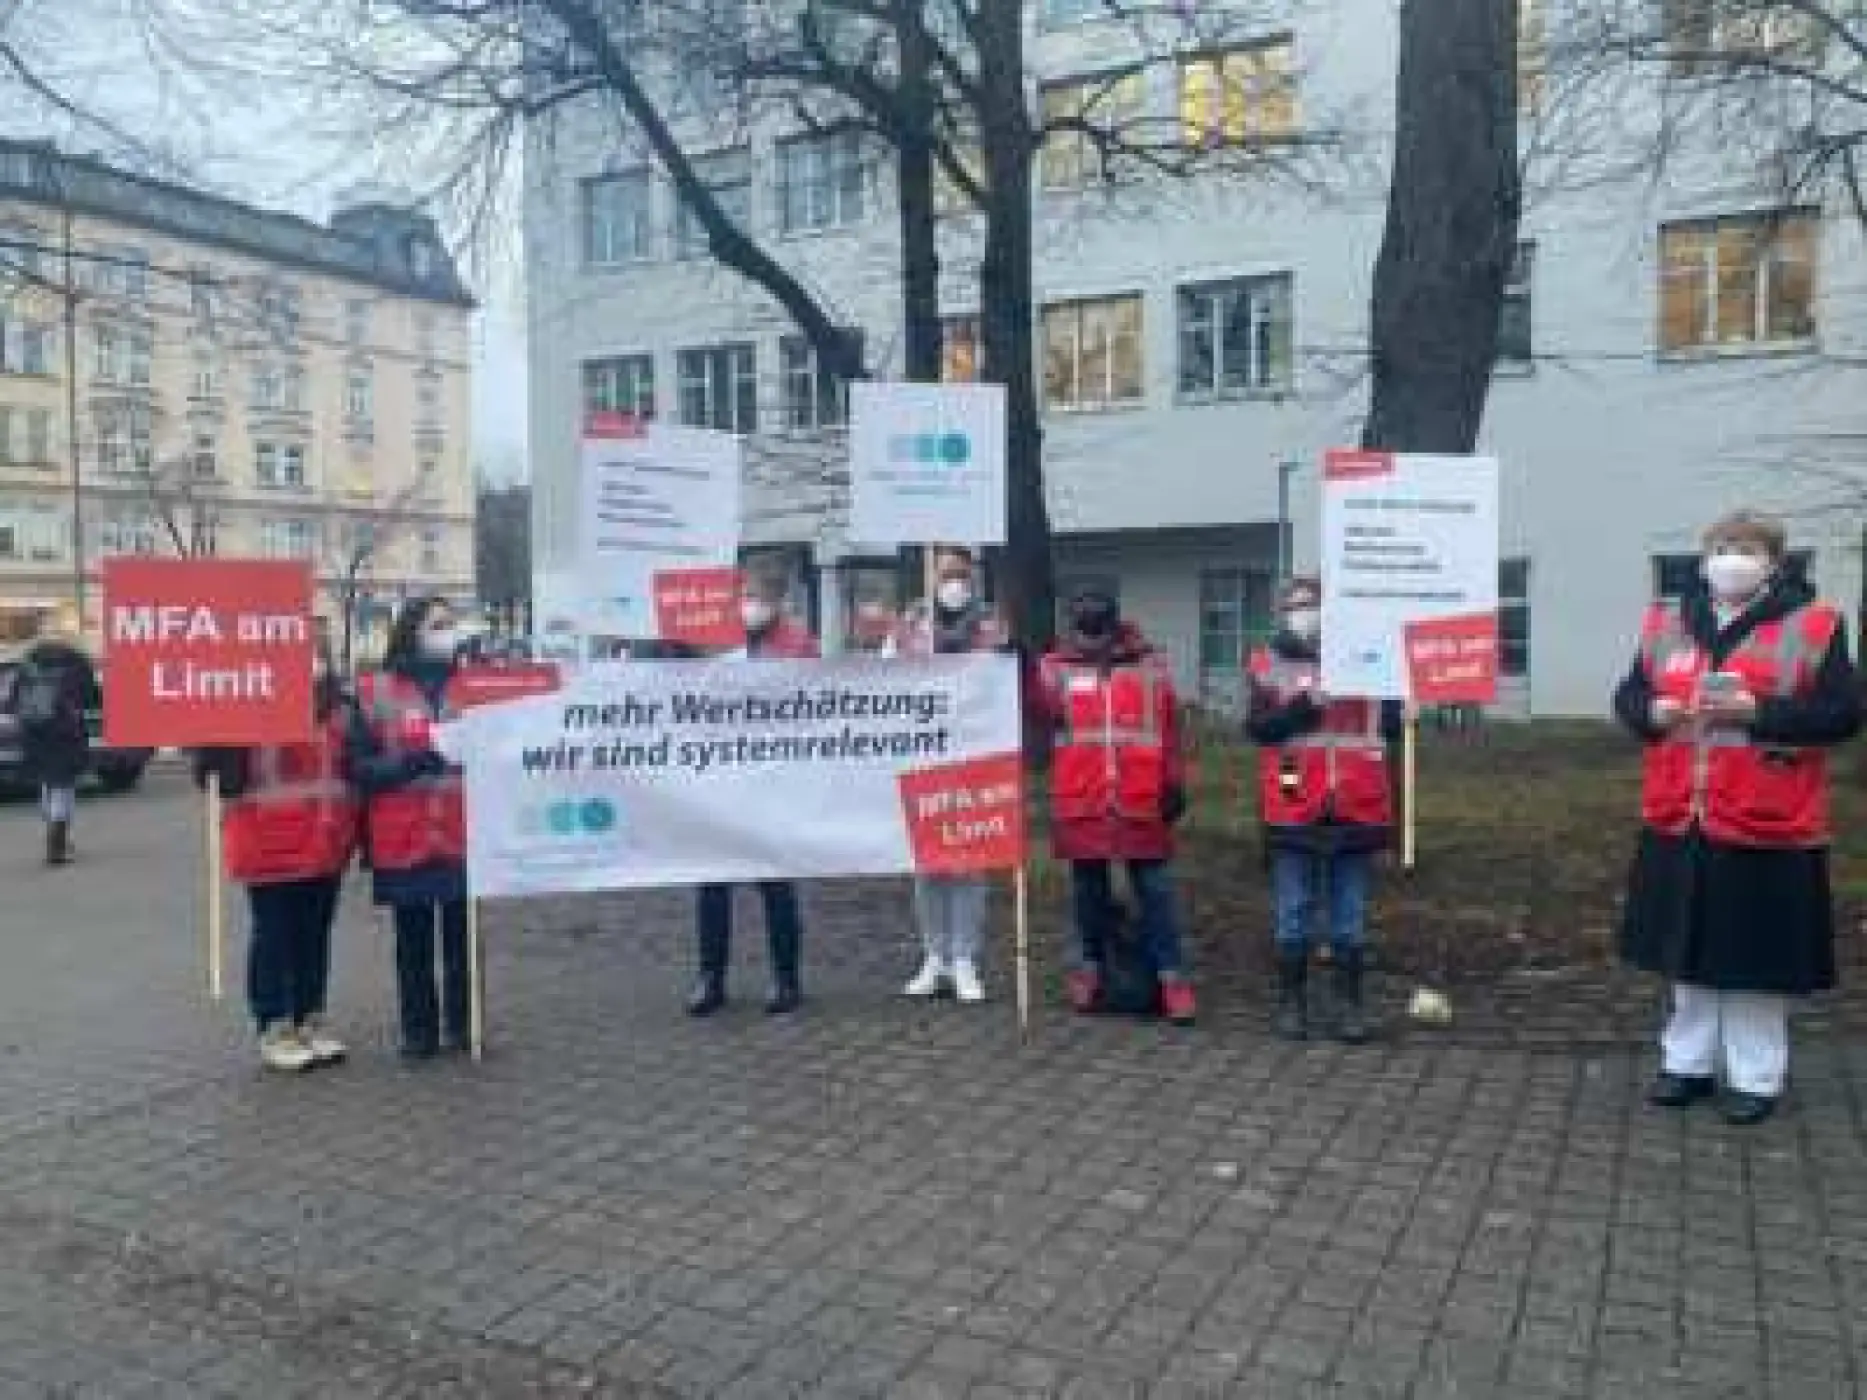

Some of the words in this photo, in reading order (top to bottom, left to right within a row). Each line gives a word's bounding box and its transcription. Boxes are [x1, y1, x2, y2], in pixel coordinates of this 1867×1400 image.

[115, 605, 220, 640] MFA
[238, 612, 308, 640] am
[153, 661, 275, 697] Limit
[564, 691, 664, 728] mehr
[522, 737, 582, 772] wir
[591, 733, 669, 767] sind
[676, 727, 949, 772] systemrelevant
